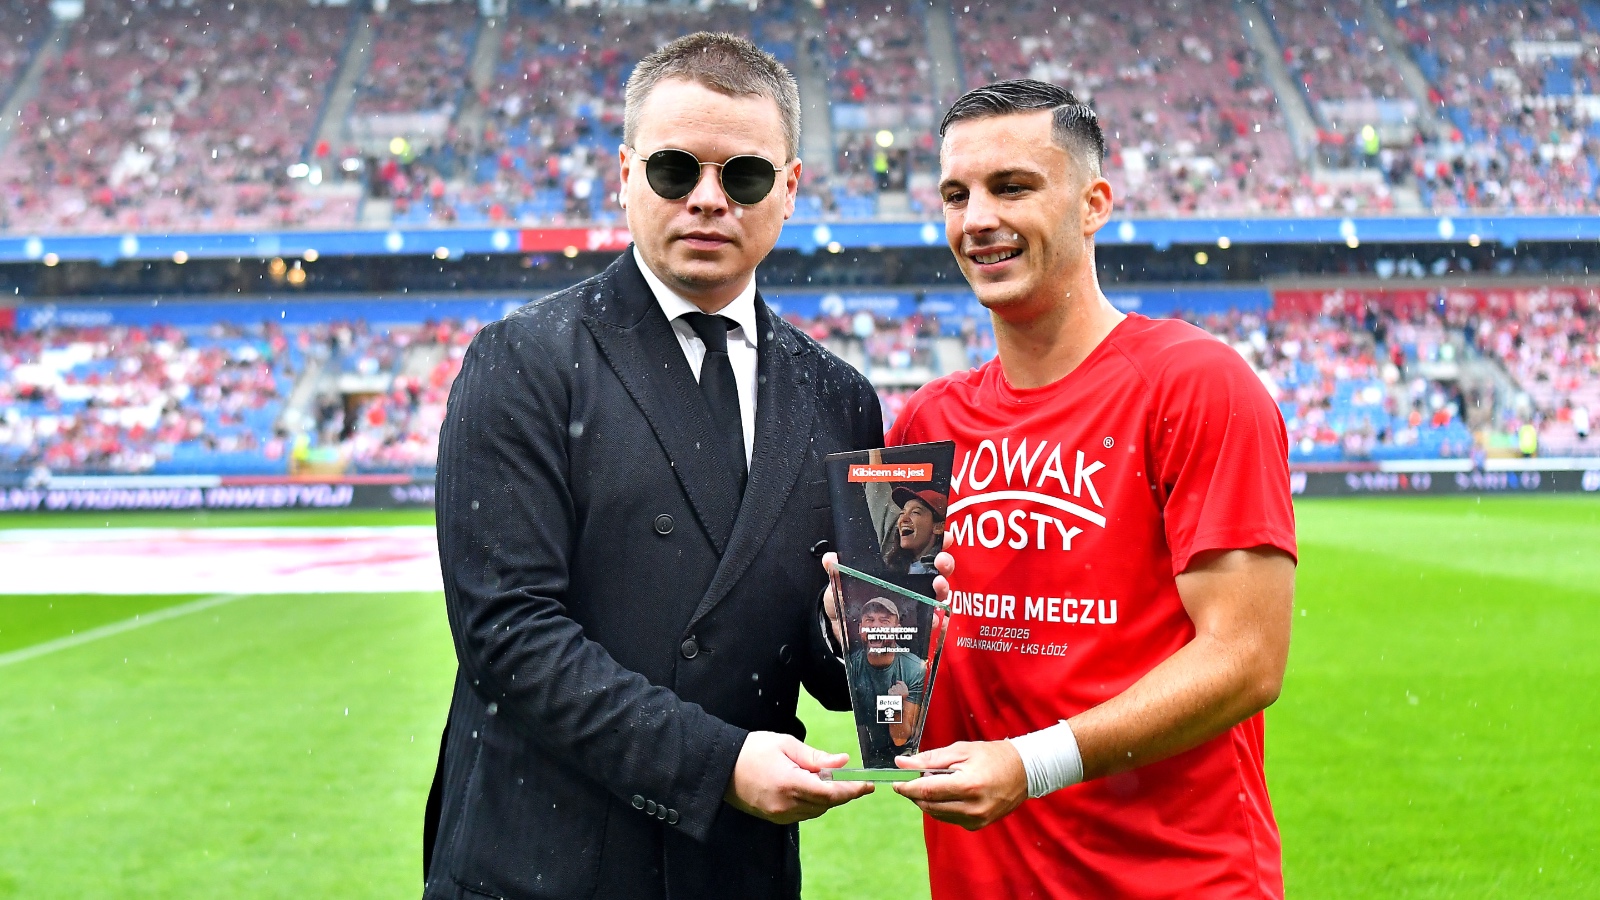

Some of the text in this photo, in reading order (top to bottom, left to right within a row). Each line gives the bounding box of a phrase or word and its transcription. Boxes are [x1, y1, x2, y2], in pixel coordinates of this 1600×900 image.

[852, 467, 925, 479] Kibicem się jest
[950, 437, 1107, 509] NOWAK
[950, 509, 1084, 551] MOSTY
[1024, 596, 1119, 625] MECZU
[979, 625, 1031, 640] 26.07.2025
[977, 638, 1013, 653] KRAKÓW
[1020, 642, 1040, 655] ŁKS
[1041, 642, 1068, 656] ŁÓDŹ
